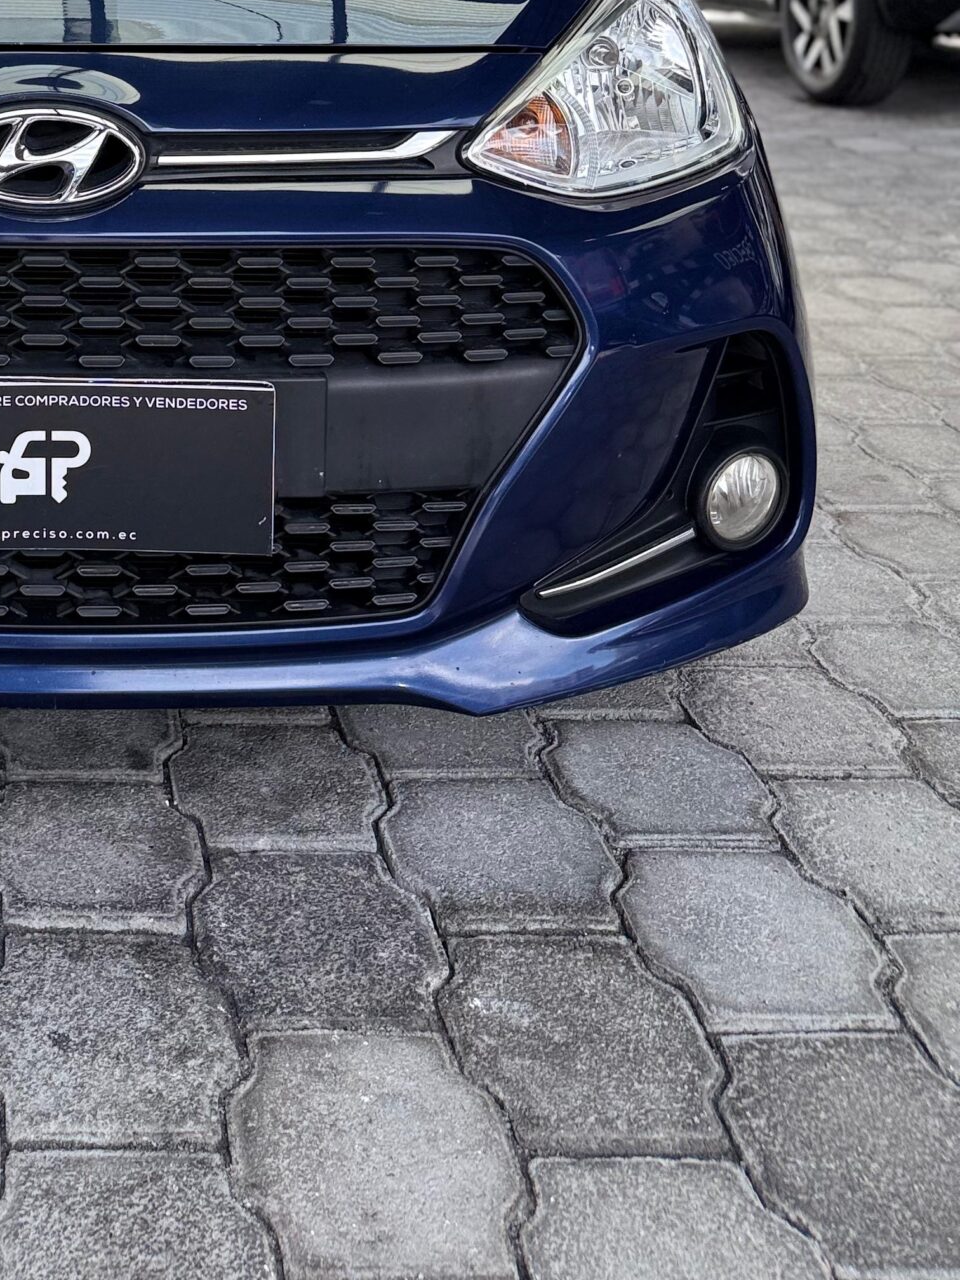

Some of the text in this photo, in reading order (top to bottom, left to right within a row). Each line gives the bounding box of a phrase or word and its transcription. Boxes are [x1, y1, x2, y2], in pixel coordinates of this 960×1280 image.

[15, 394, 130, 408] COMPRADORES
[133, 396, 143, 408] Y
[145, 397, 248, 411] VENDEDORES
